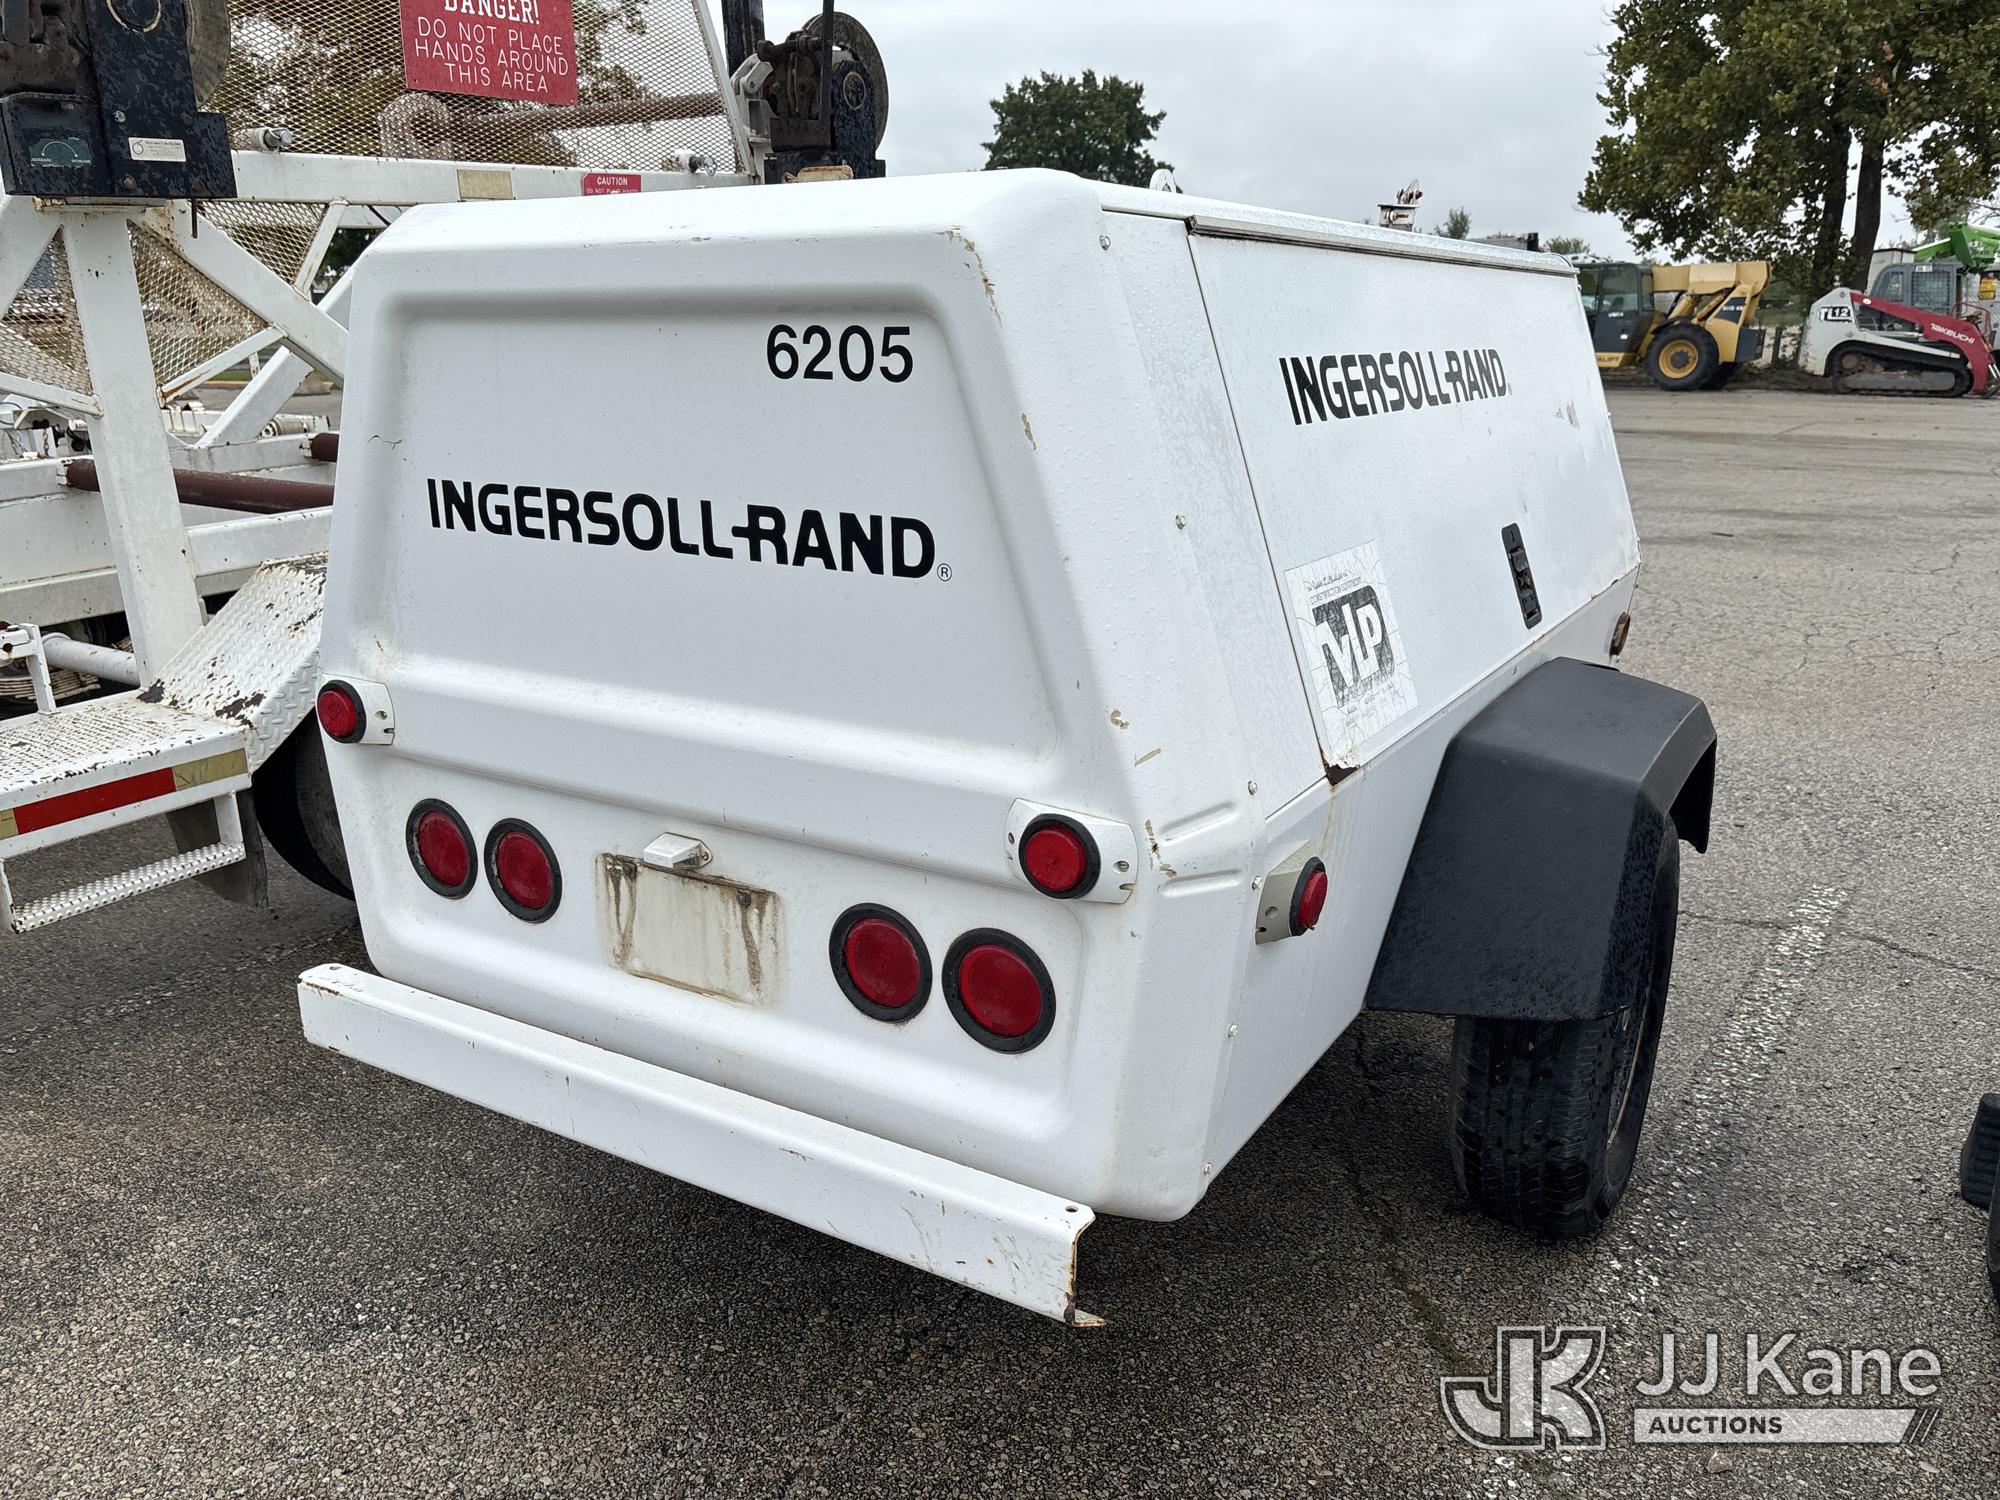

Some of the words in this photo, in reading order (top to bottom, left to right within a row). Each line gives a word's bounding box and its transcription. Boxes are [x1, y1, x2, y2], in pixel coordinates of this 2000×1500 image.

[417, 16, 447, 39] DO
[458, 22, 497, 45] NOT
[508, 29, 564, 56] PLACE
[414, 38, 486, 65] HANDS
[497, 49, 569, 76] AROUND
[444, 62, 491, 87] THIS
[501, 70, 548, 93] AREA
[596, 176, 628, 186] CAUTION
[766, 324, 914, 383] 6205
[1279, 348, 1507, 426] INGERSOLL-RAND
[426, 478, 936, 579] INGERSOLL-RAND
